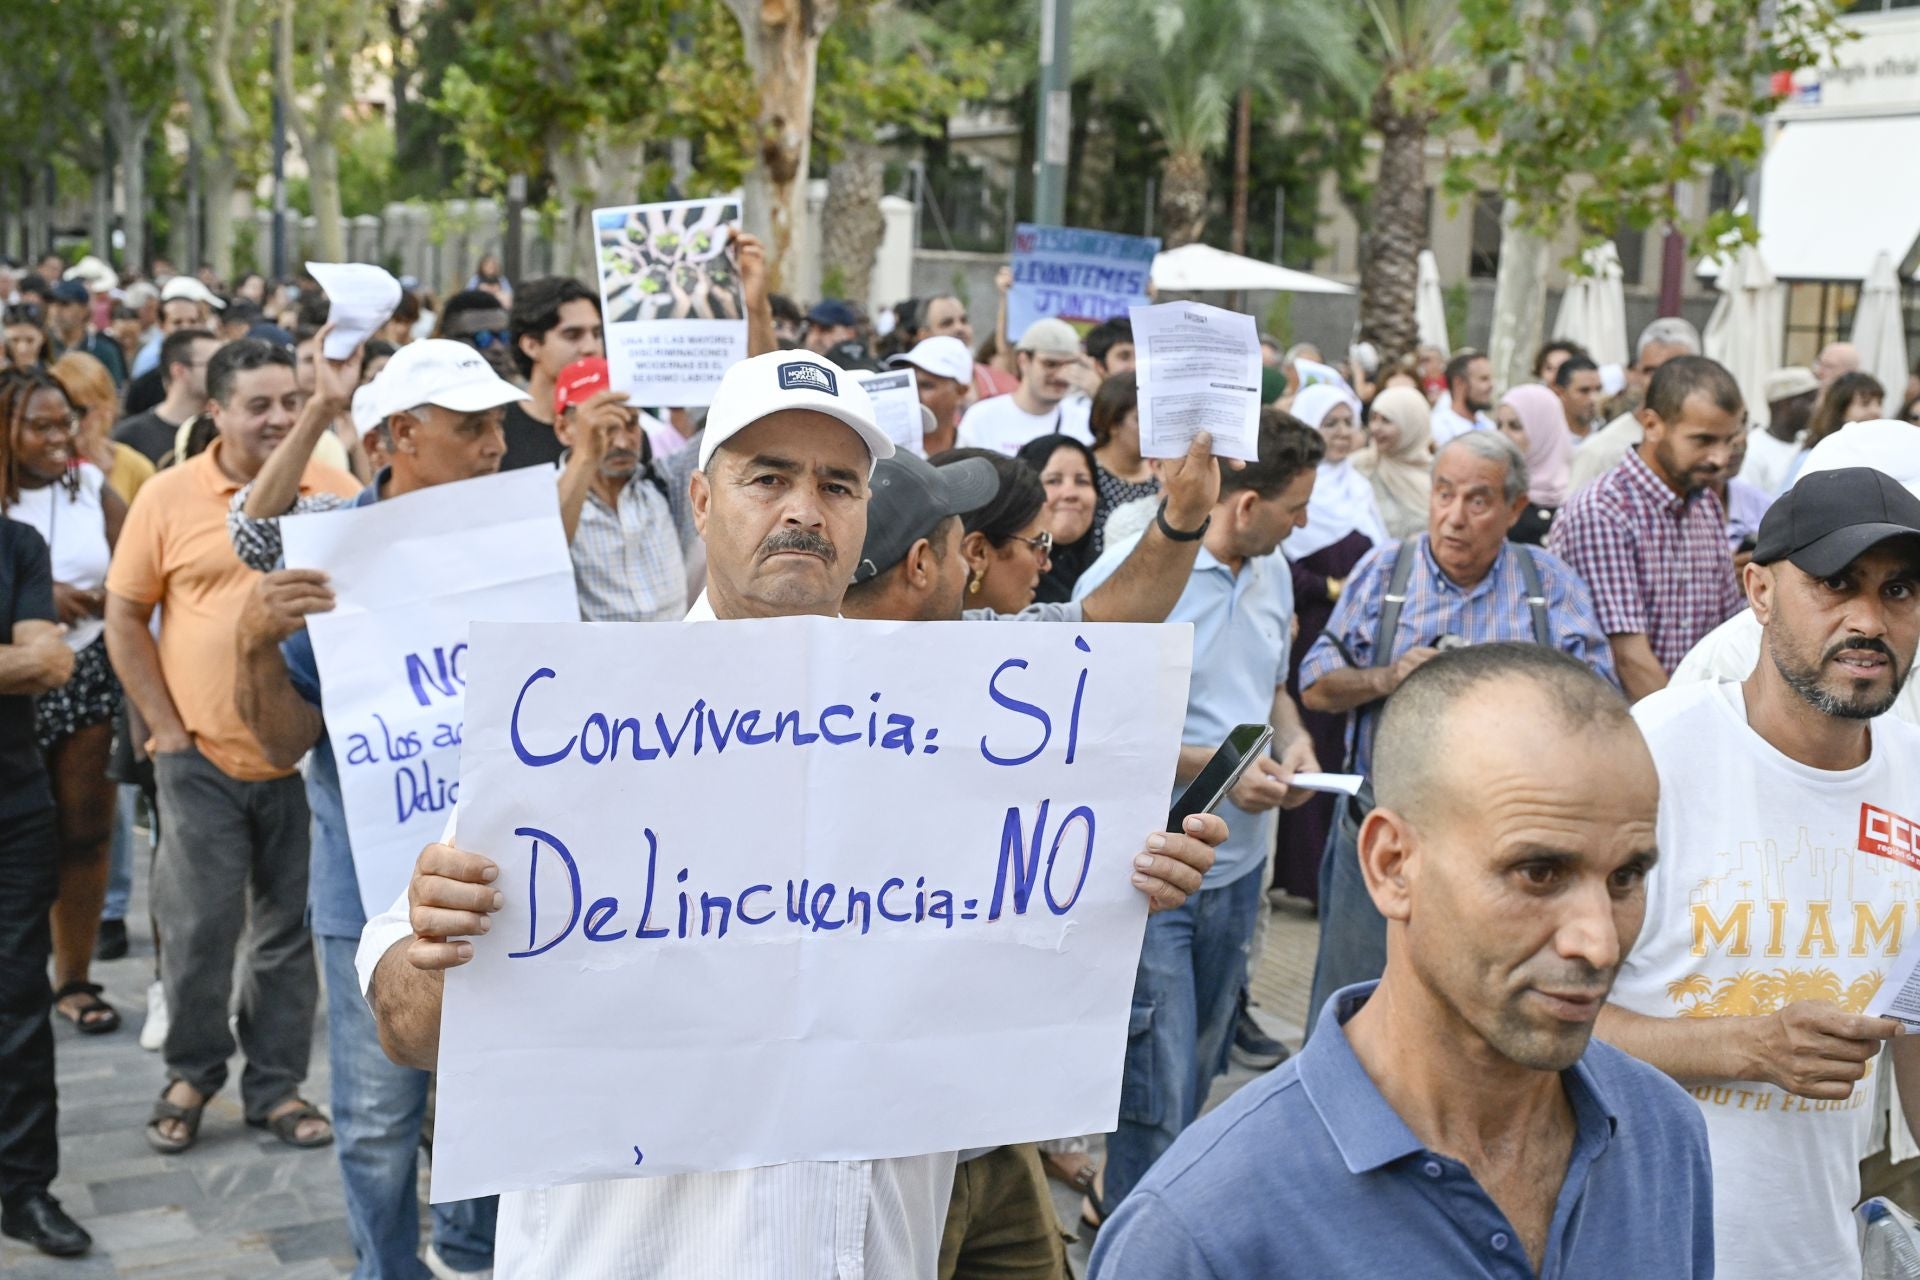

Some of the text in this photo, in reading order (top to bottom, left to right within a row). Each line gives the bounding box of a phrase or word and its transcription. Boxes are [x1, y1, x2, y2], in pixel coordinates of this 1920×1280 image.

[649, 335, 660, 345] DE
[688, 335, 735, 345] MAYORES
[636, 361, 694, 370] MODERNAS
[698, 361, 709, 370] ES
[682, 373, 723, 383] LABORA
[511, 667, 940, 768] Convivencia:
[372, 713, 422, 761] los
[988, 799, 1097, 922] NO
[1690, 1084, 1773, 1113] OUTH
